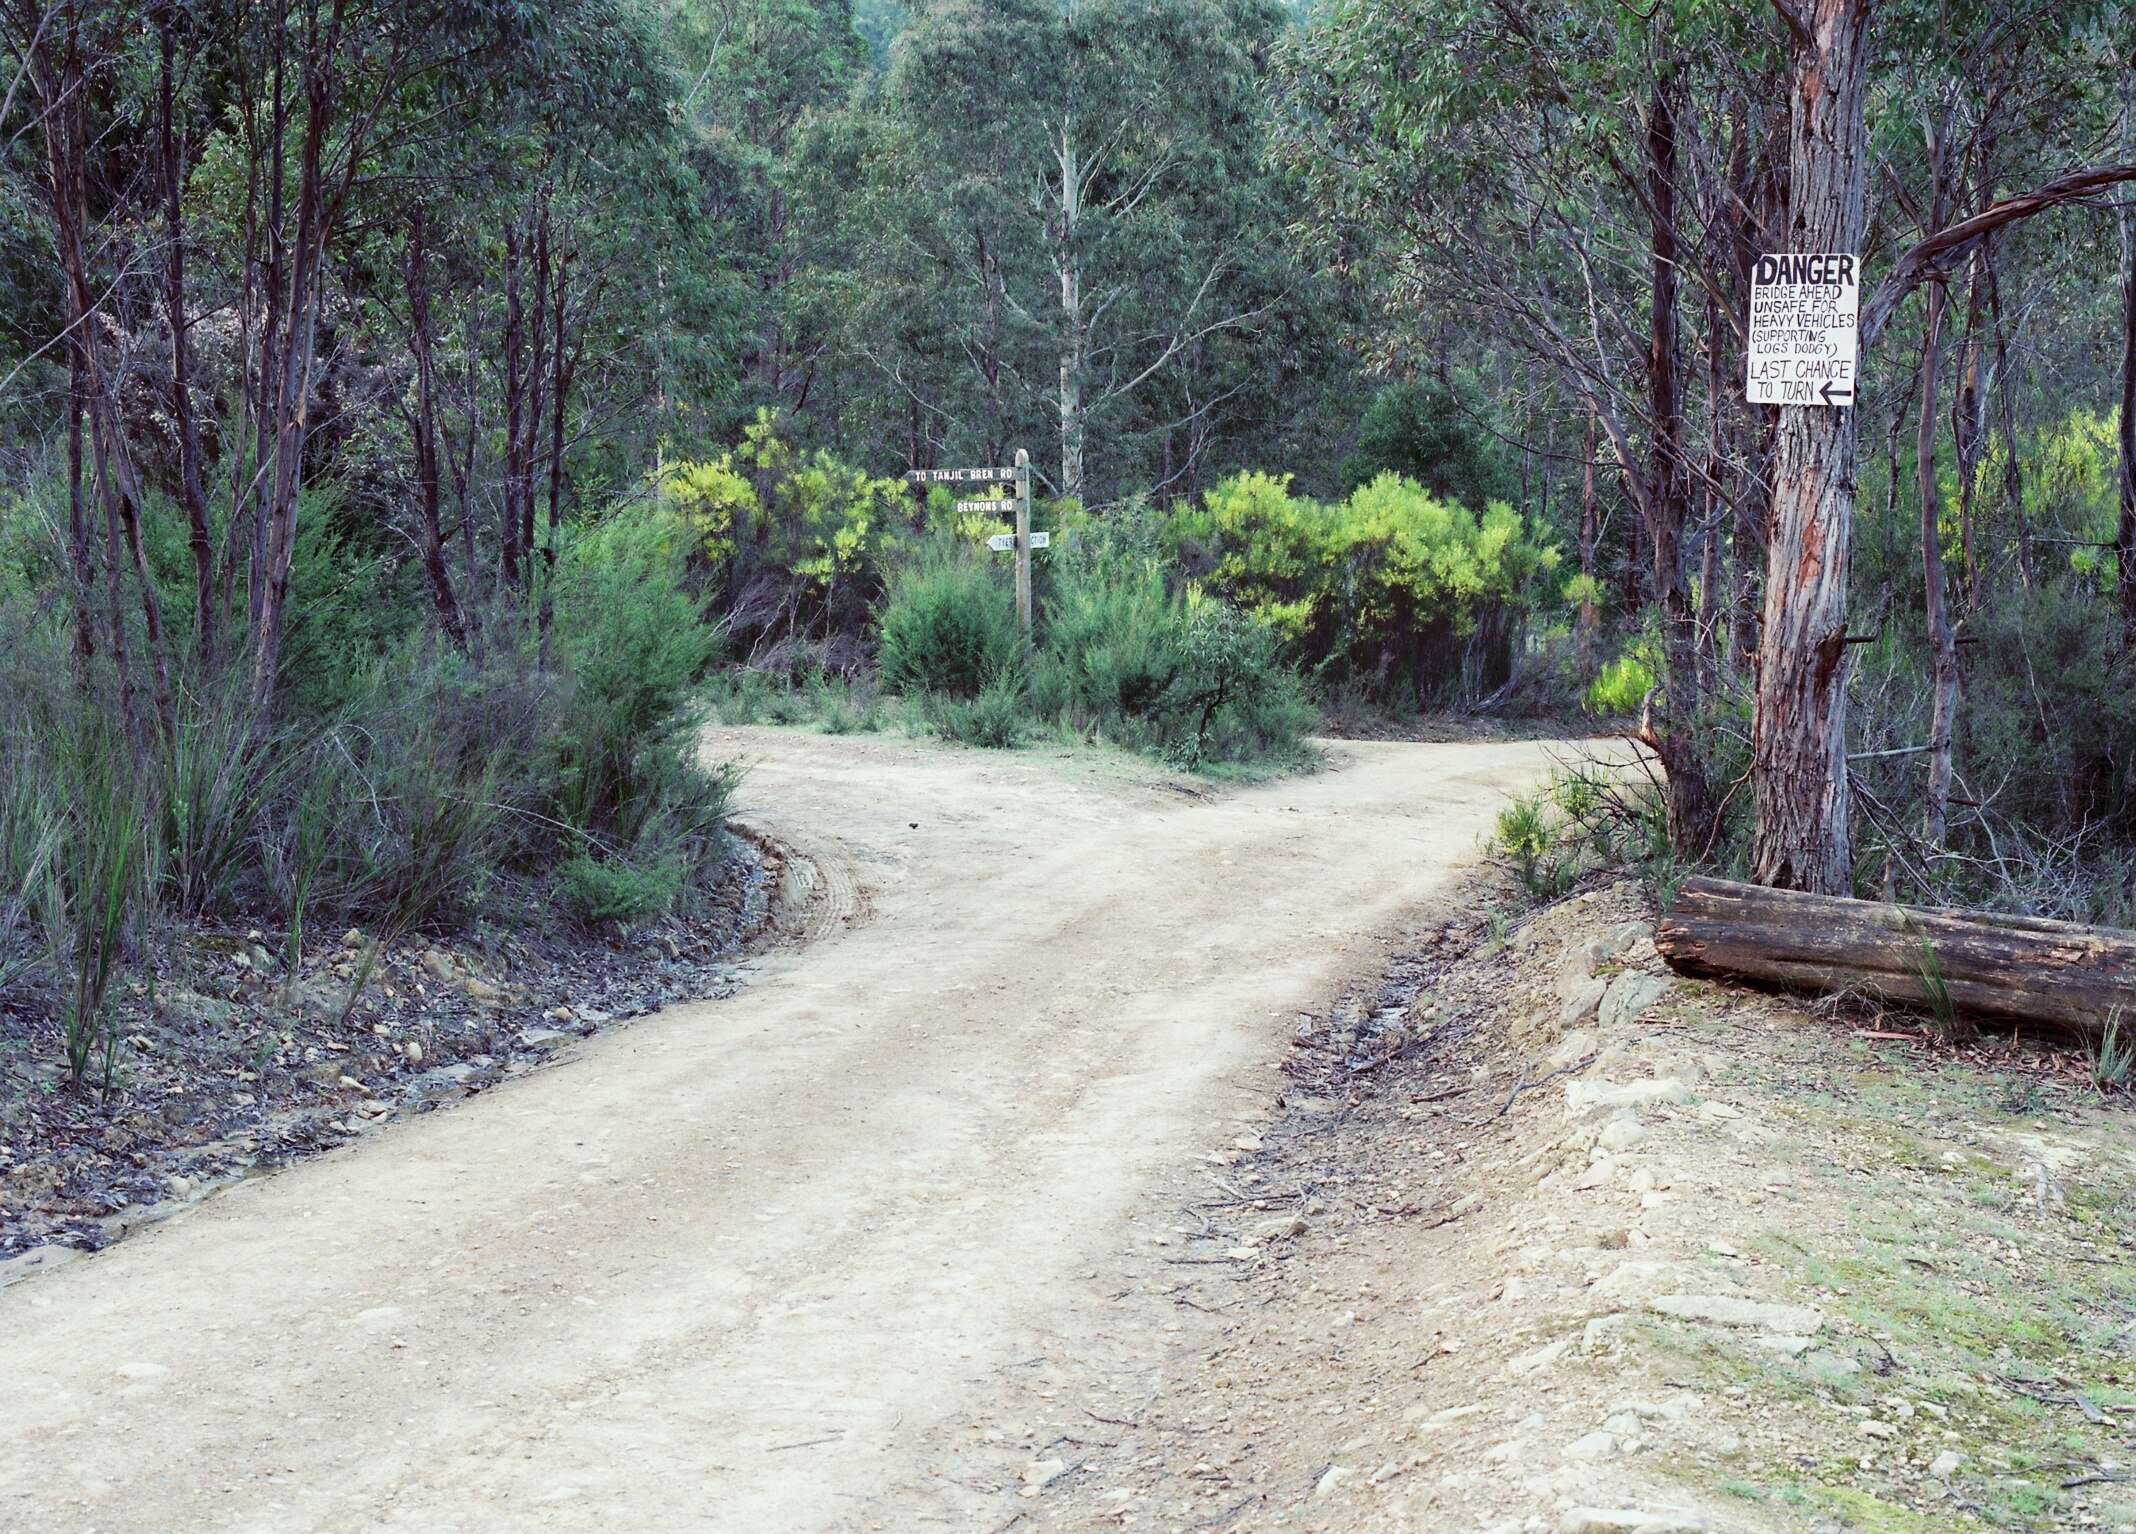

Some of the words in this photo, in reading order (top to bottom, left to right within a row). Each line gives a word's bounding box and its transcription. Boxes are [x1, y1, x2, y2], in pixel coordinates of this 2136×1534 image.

[1755, 255, 1854, 286] DANGER
[1755, 285, 1796, 300] BRIDGE
[1798, 285, 1842, 300] AHEAD
[1754, 300, 1807, 314] UNSAFE
[1812, 300, 1838, 314] FOR
[1753, 313, 1794, 328] HEAVY
[1797, 313, 1855, 329] VEHICLES
[1752, 329, 1826, 343] (SUPPORTING
[1757, 343, 1789, 354] LOGS
[1794, 343, 1838, 358] DODGY)
[1750, 360, 1791, 379] LAST
[1795, 360, 1852, 379] CHANCE
[1757, 381, 1773, 399] TO
[1781, 381, 1814, 401] TURN
[915, 471, 927, 481] TO
[933, 470, 963, 481] TANJIL
[970, 469, 993, 480] BREN
[1000, 468, 1013, 479] RD
[957, 501, 997, 512] BEYNONS
[1000, 500, 1013, 511] RD
